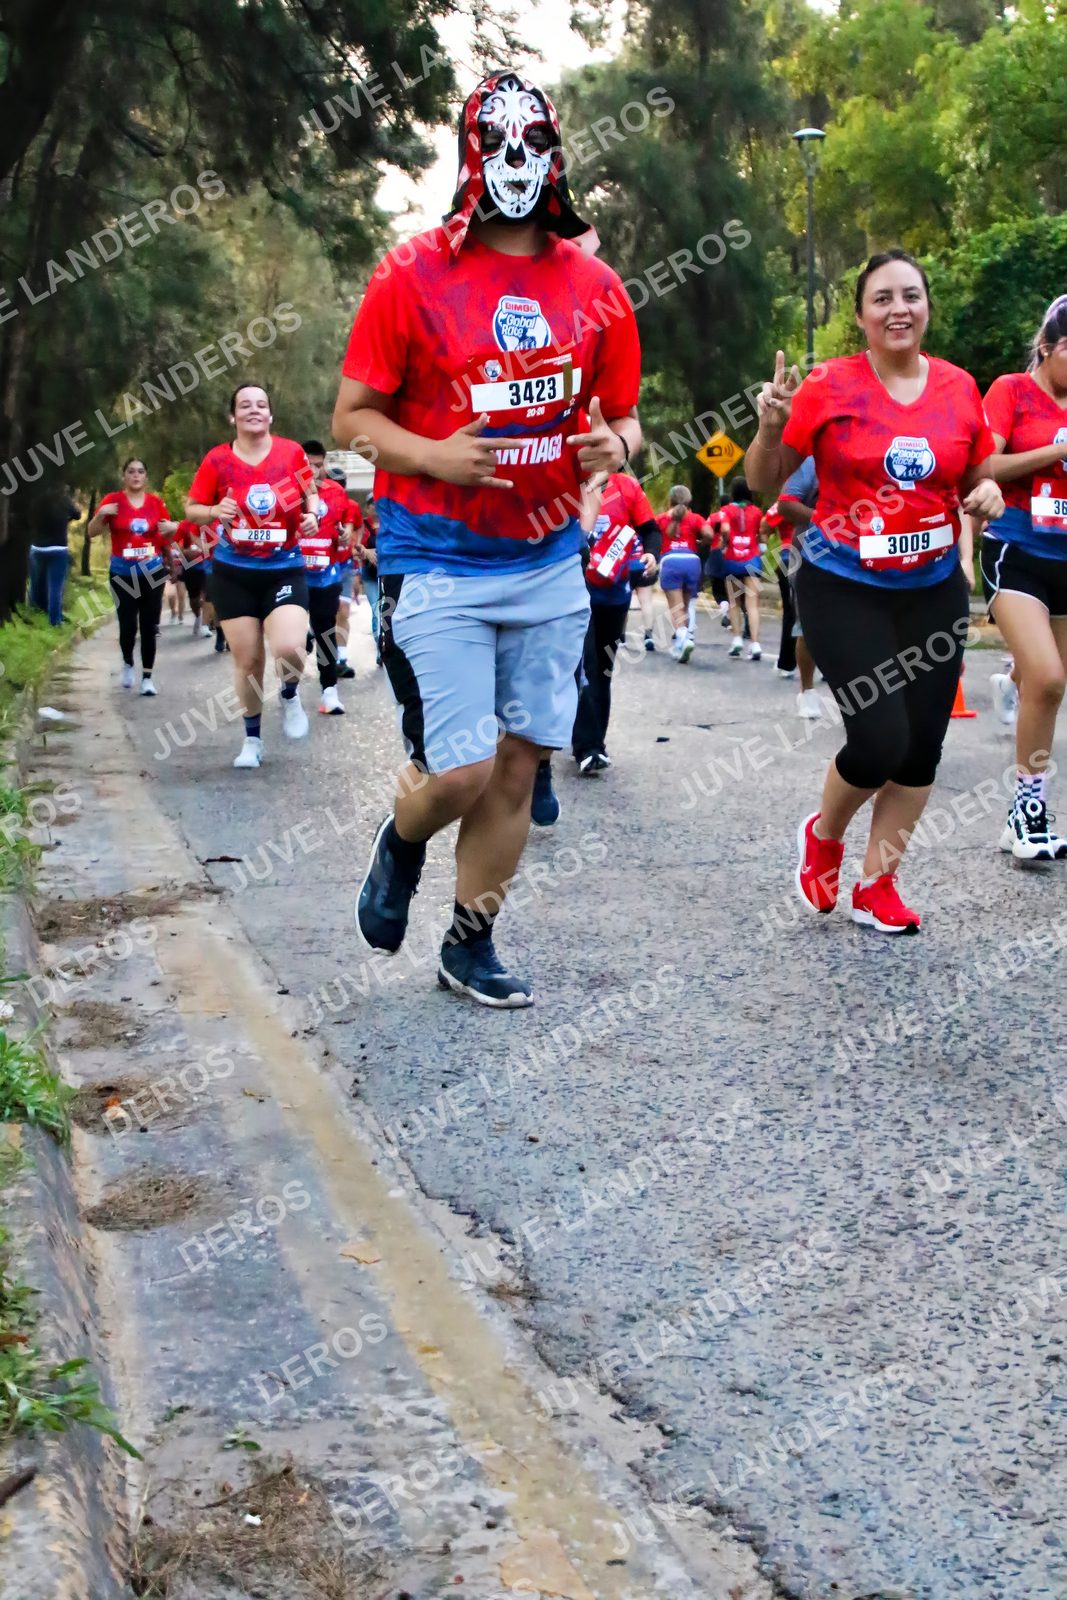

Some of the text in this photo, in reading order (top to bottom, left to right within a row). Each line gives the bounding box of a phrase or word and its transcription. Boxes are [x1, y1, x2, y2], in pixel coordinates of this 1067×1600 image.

[505, 302, 536, 313] BIMBO
[506, 314, 536, 329] Global
[502, 326, 524, 337] Race
[509, 376, 557, 406] 3423
[248, 530, 271, 540] 2828
[607, 538, 624, 561] 3627
[888, 532, 930, 555] 3009
